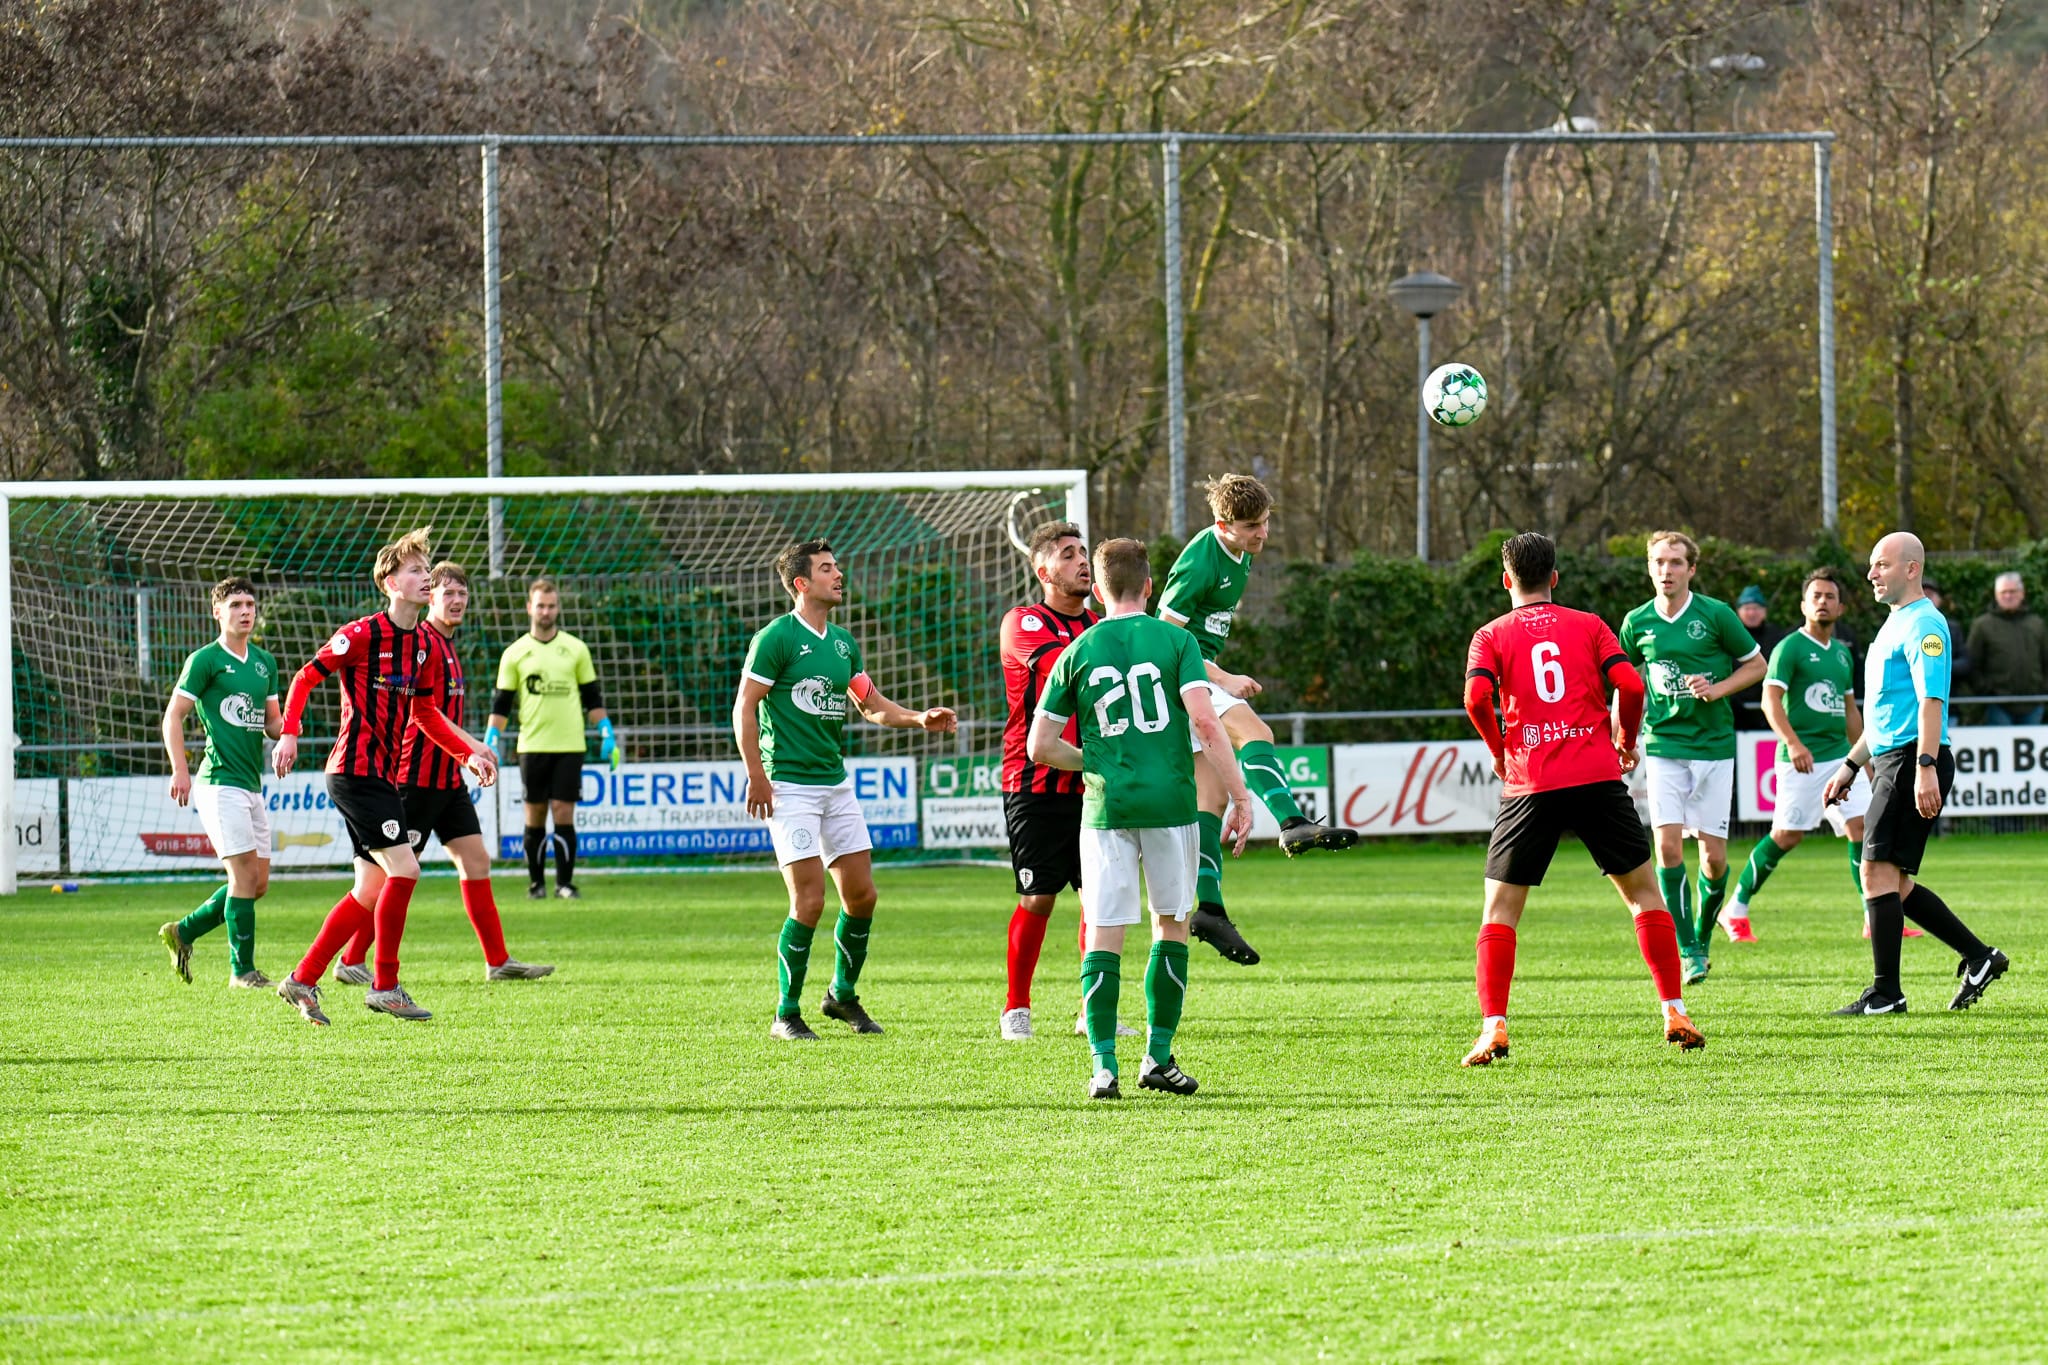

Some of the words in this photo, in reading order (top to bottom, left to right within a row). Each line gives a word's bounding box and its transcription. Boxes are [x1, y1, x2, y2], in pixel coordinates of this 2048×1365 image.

[1923, 641, 1942, 650] ARAG
[1531, 640, 1566, 704] 6
[816, 695, 827, 709] De
[1087, 661, 1170, 738] 20
[1543, 720, 1569, 732] ALL
[1544, 726, 1595, 743] SAFETY
[576, 811, 638, 828] BORRA
